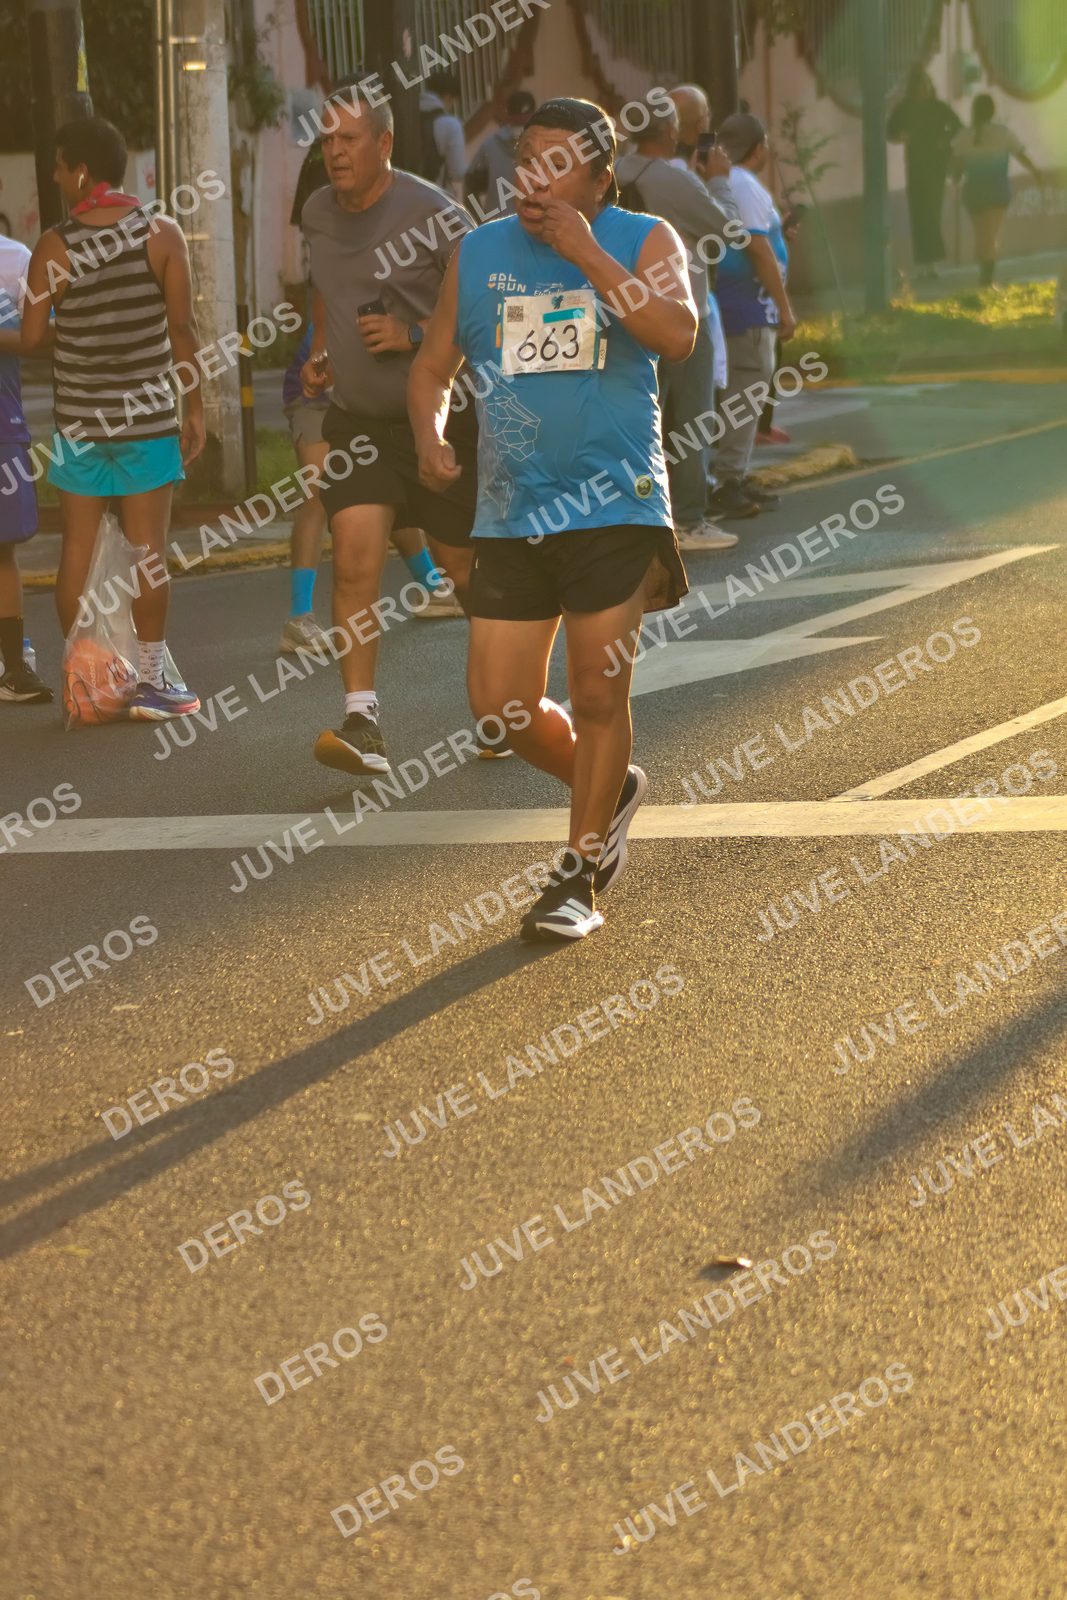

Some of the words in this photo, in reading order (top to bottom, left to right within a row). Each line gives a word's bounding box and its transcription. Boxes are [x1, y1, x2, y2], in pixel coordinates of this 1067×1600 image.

[489, 273, 517, 283] GDL
[497, 282, 526, 293] RUN
[516, 324, 579, 362] 663
